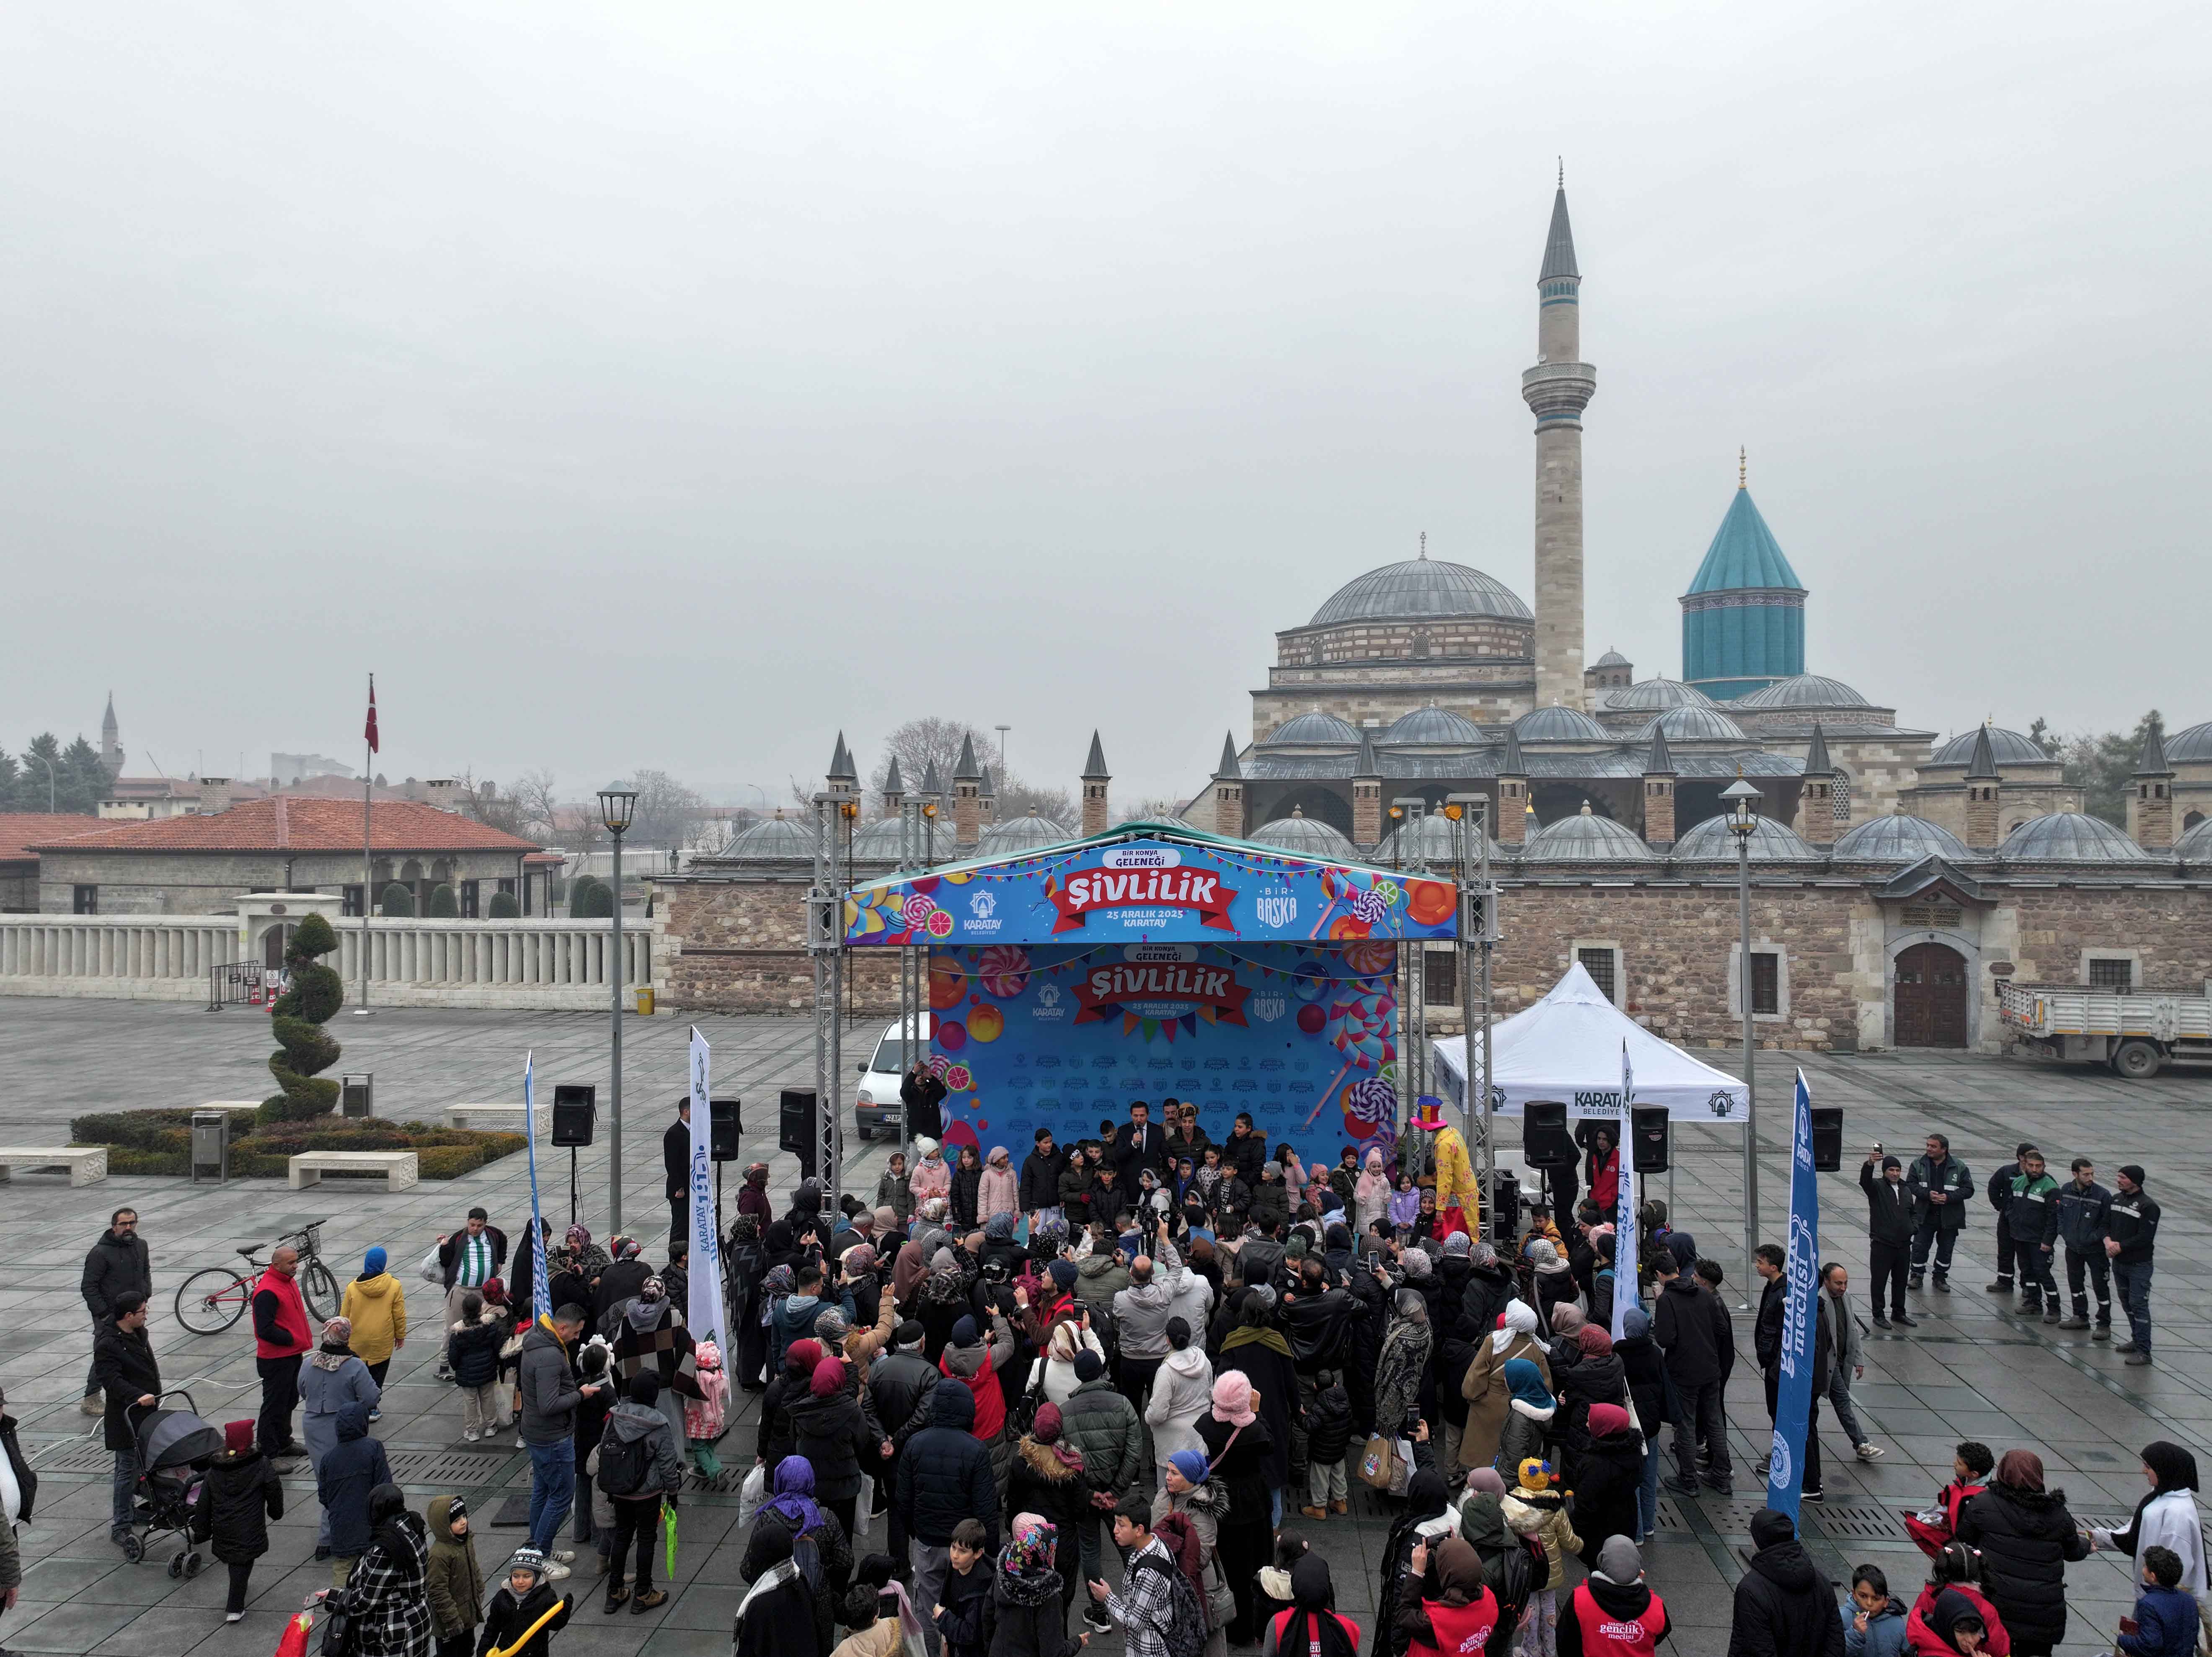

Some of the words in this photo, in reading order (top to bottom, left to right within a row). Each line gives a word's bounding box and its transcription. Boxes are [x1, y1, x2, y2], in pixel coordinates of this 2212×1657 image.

[1116, 856, 1165, 867] GELENEĞİ
[1069, 870, 1217, 910] ŞİVLİLİK
[964, 919, 1002, 930] KARATAY
[1257, 898, 1297, 928] BAŞKA
[1136, 952, 1181, 961] GELENEĞİ
[1092, 965, 1229, 1000] ŞİVLİLİK
[1033, 1008, 1065, 1017] KARATAY
[696, 1205, 709, 1252] KARATAY
[1795, 1256, 1808, 1356] meclisi
